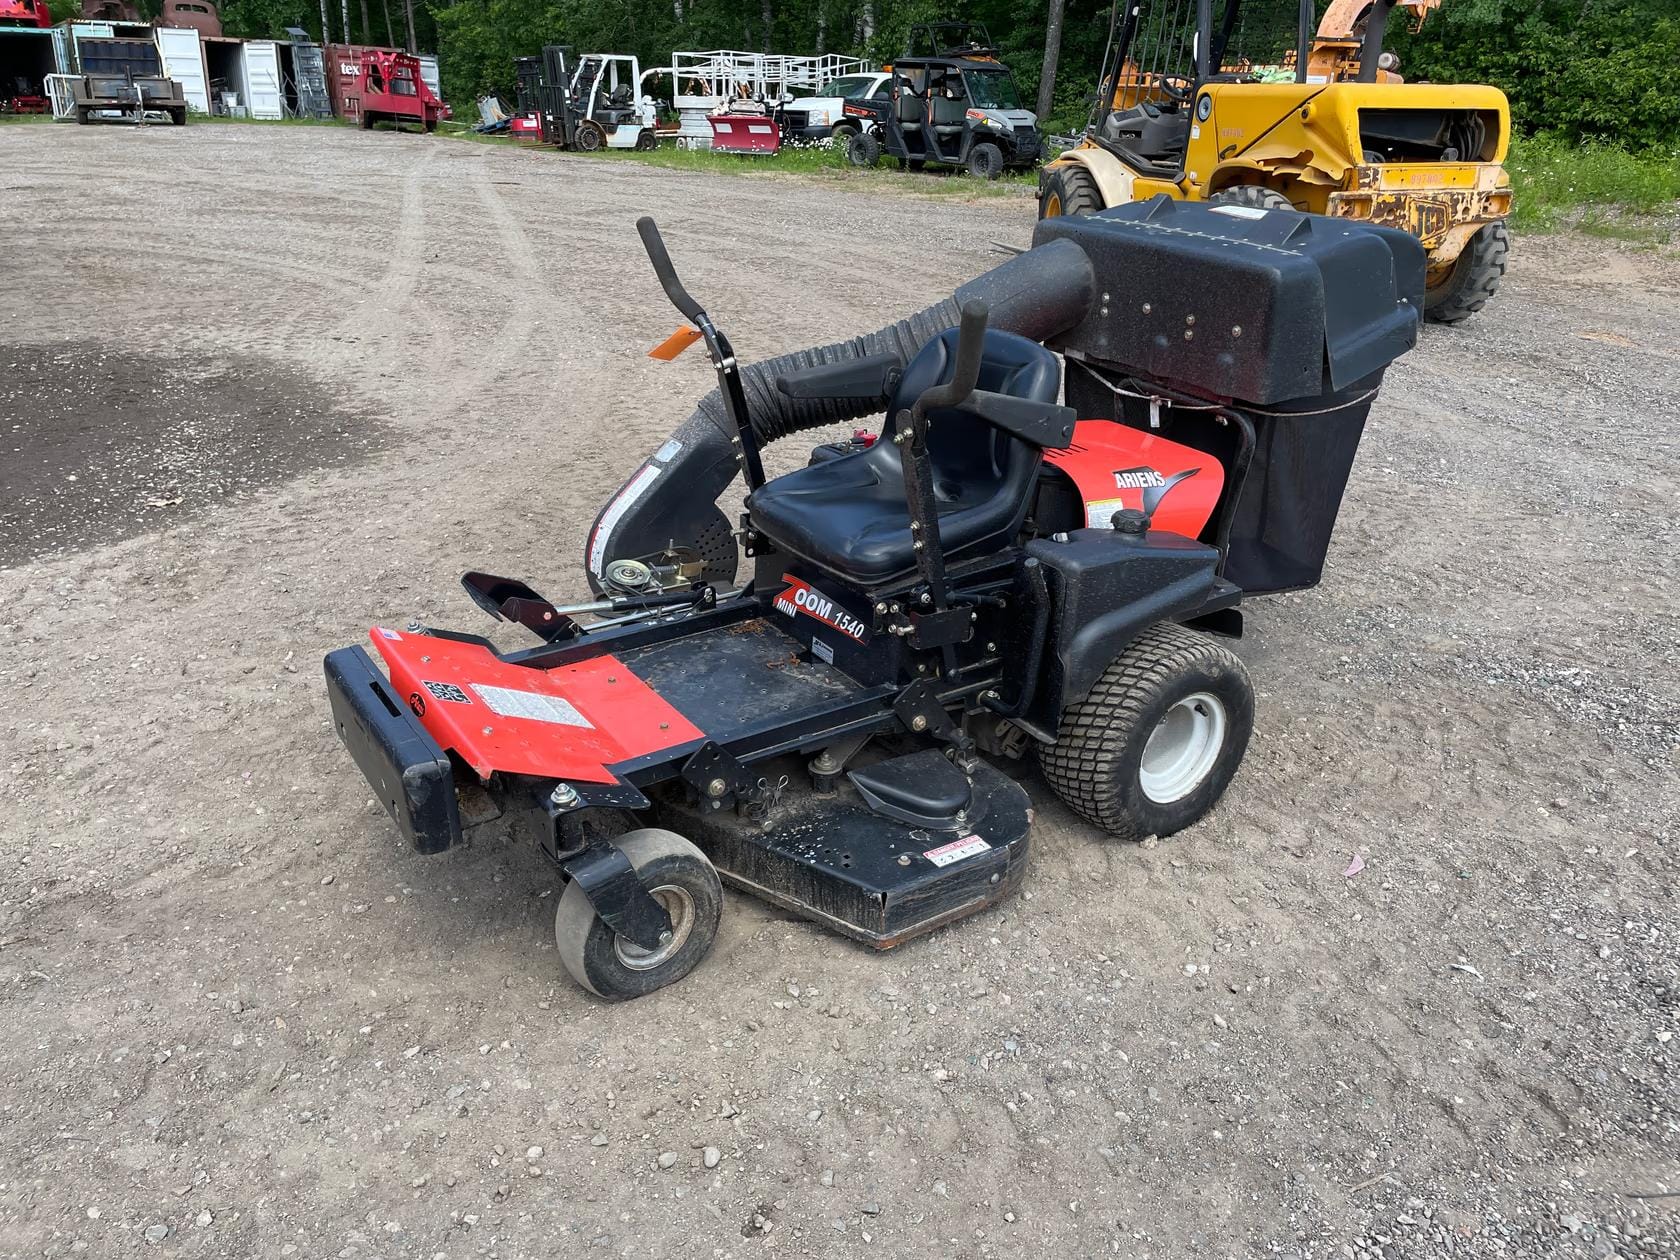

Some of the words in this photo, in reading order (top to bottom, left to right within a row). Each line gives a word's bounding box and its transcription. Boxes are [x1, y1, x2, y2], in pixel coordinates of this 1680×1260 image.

[340, 62, 360, 75] tex
[1115, 472, 1165, 488] ARIENS
[777, 598, 798, 618] MINI
[834, 612, 865, 638] 1540
